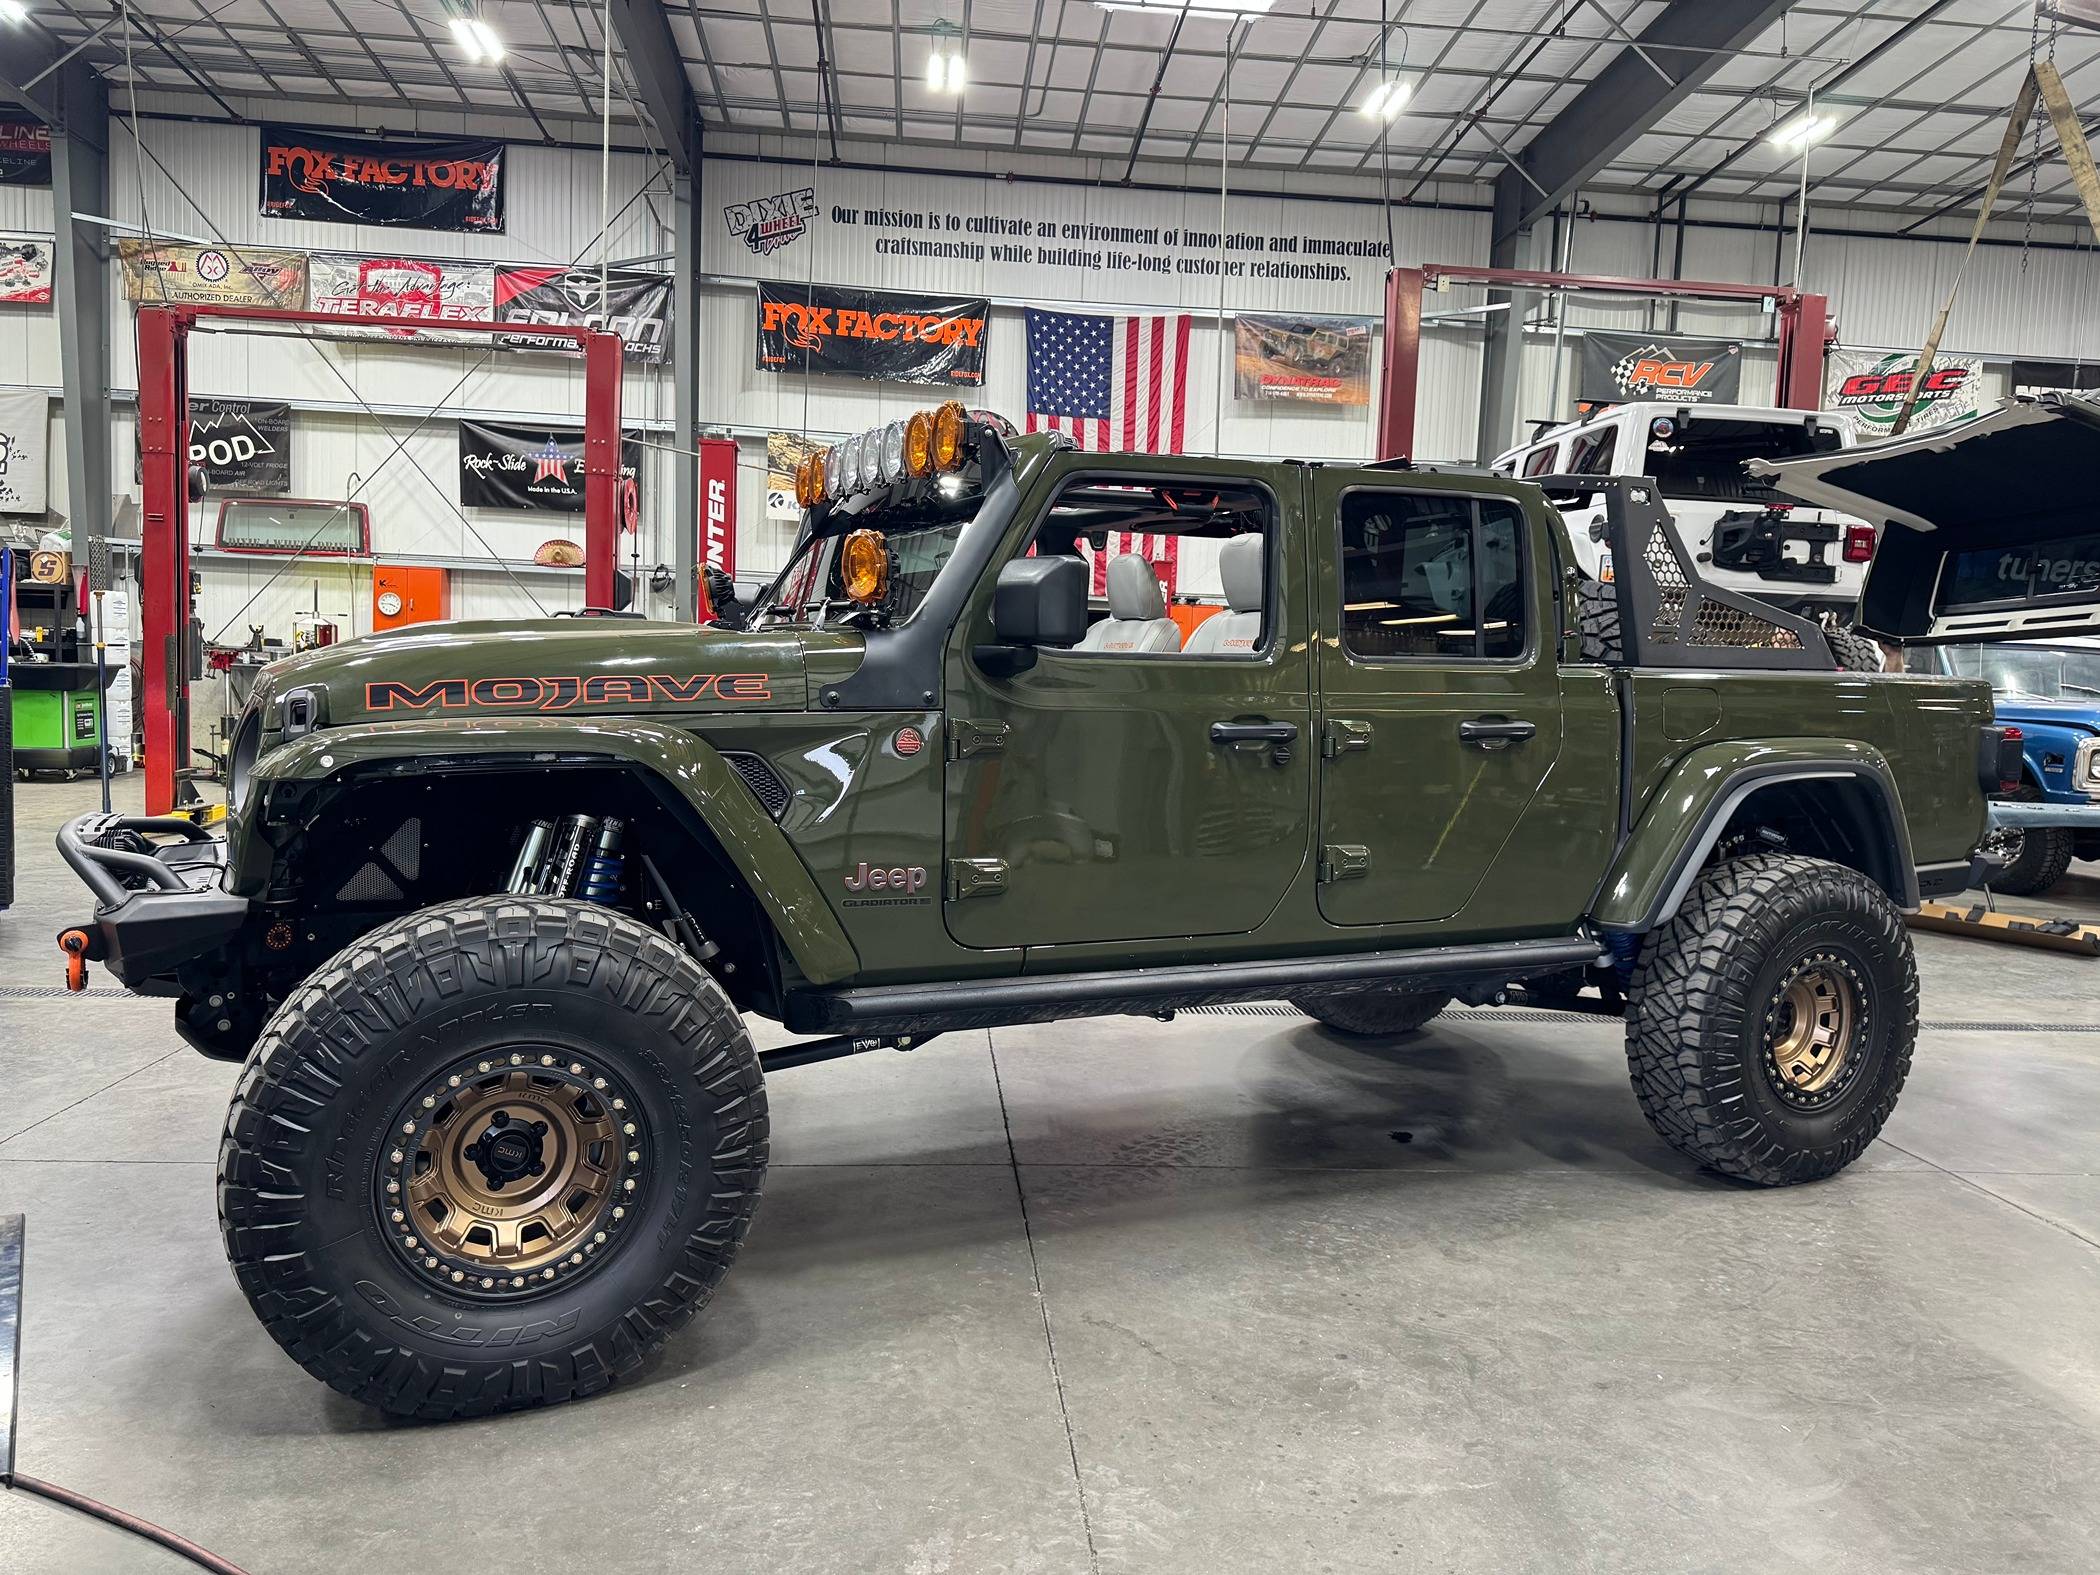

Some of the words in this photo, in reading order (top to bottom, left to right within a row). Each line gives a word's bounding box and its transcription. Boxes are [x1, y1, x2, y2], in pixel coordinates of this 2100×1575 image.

[267, 146, 336, 190] FOX
[343, 157, 498, 191] FACTORY
[723, 187, 819, 236] DIXIE
[760, 215, 801, 234] WHEEL
[831, 205, 859, 225] Our
[864, 207, 923, 229] mission
[928, 212, 941, 230] is
[945, 213, 961, 232] to
[965, 215, 1032, 237] cultivate
[1037, 221, 1057, 238] an
[1061, 222, 1159, 246] environment
[1163, 228, 1180, 247] of
[1183, 229, 1264, 251] innovation
[1269, 235, 1298, 253] and
[1302, 236, 1391, 258] immaculate
[875, 236, 985, 262] craftsmanship
[990, 242, 1033, 264] while
[1037, 245, 1102, 271] building
[1106, 251, 1171, 275] life-long
[1176, 256, 1246, 277] customer
[1250, 260, 1351, 282] relationships.
[171, 291, 222, 302] AUTHORIZED
[223, 293, 253, 303] DEALER
[332, 280, 362, 297] Get
[319, 297, 489, 322] TERAFLEX
[763, 303, 832, 352] FOX
[836, 309, 983, 347] FACTORY
[1628, 358, 1714, 388] RCV
[1656, 388, 1713, 398] PERFORMANCE
[1656, 394, 1699, 402] PRODUCTS
[1841, 390, 1952, 404] MOTORSORTS
[211, 401, 251, 414] Control
[551, 486, 561, 494] the
[365, 673, 771, 710] MOJAVE
[844, 862, 927, 894] Jeep
[842, 898, 918, 908] GLADIATOR
